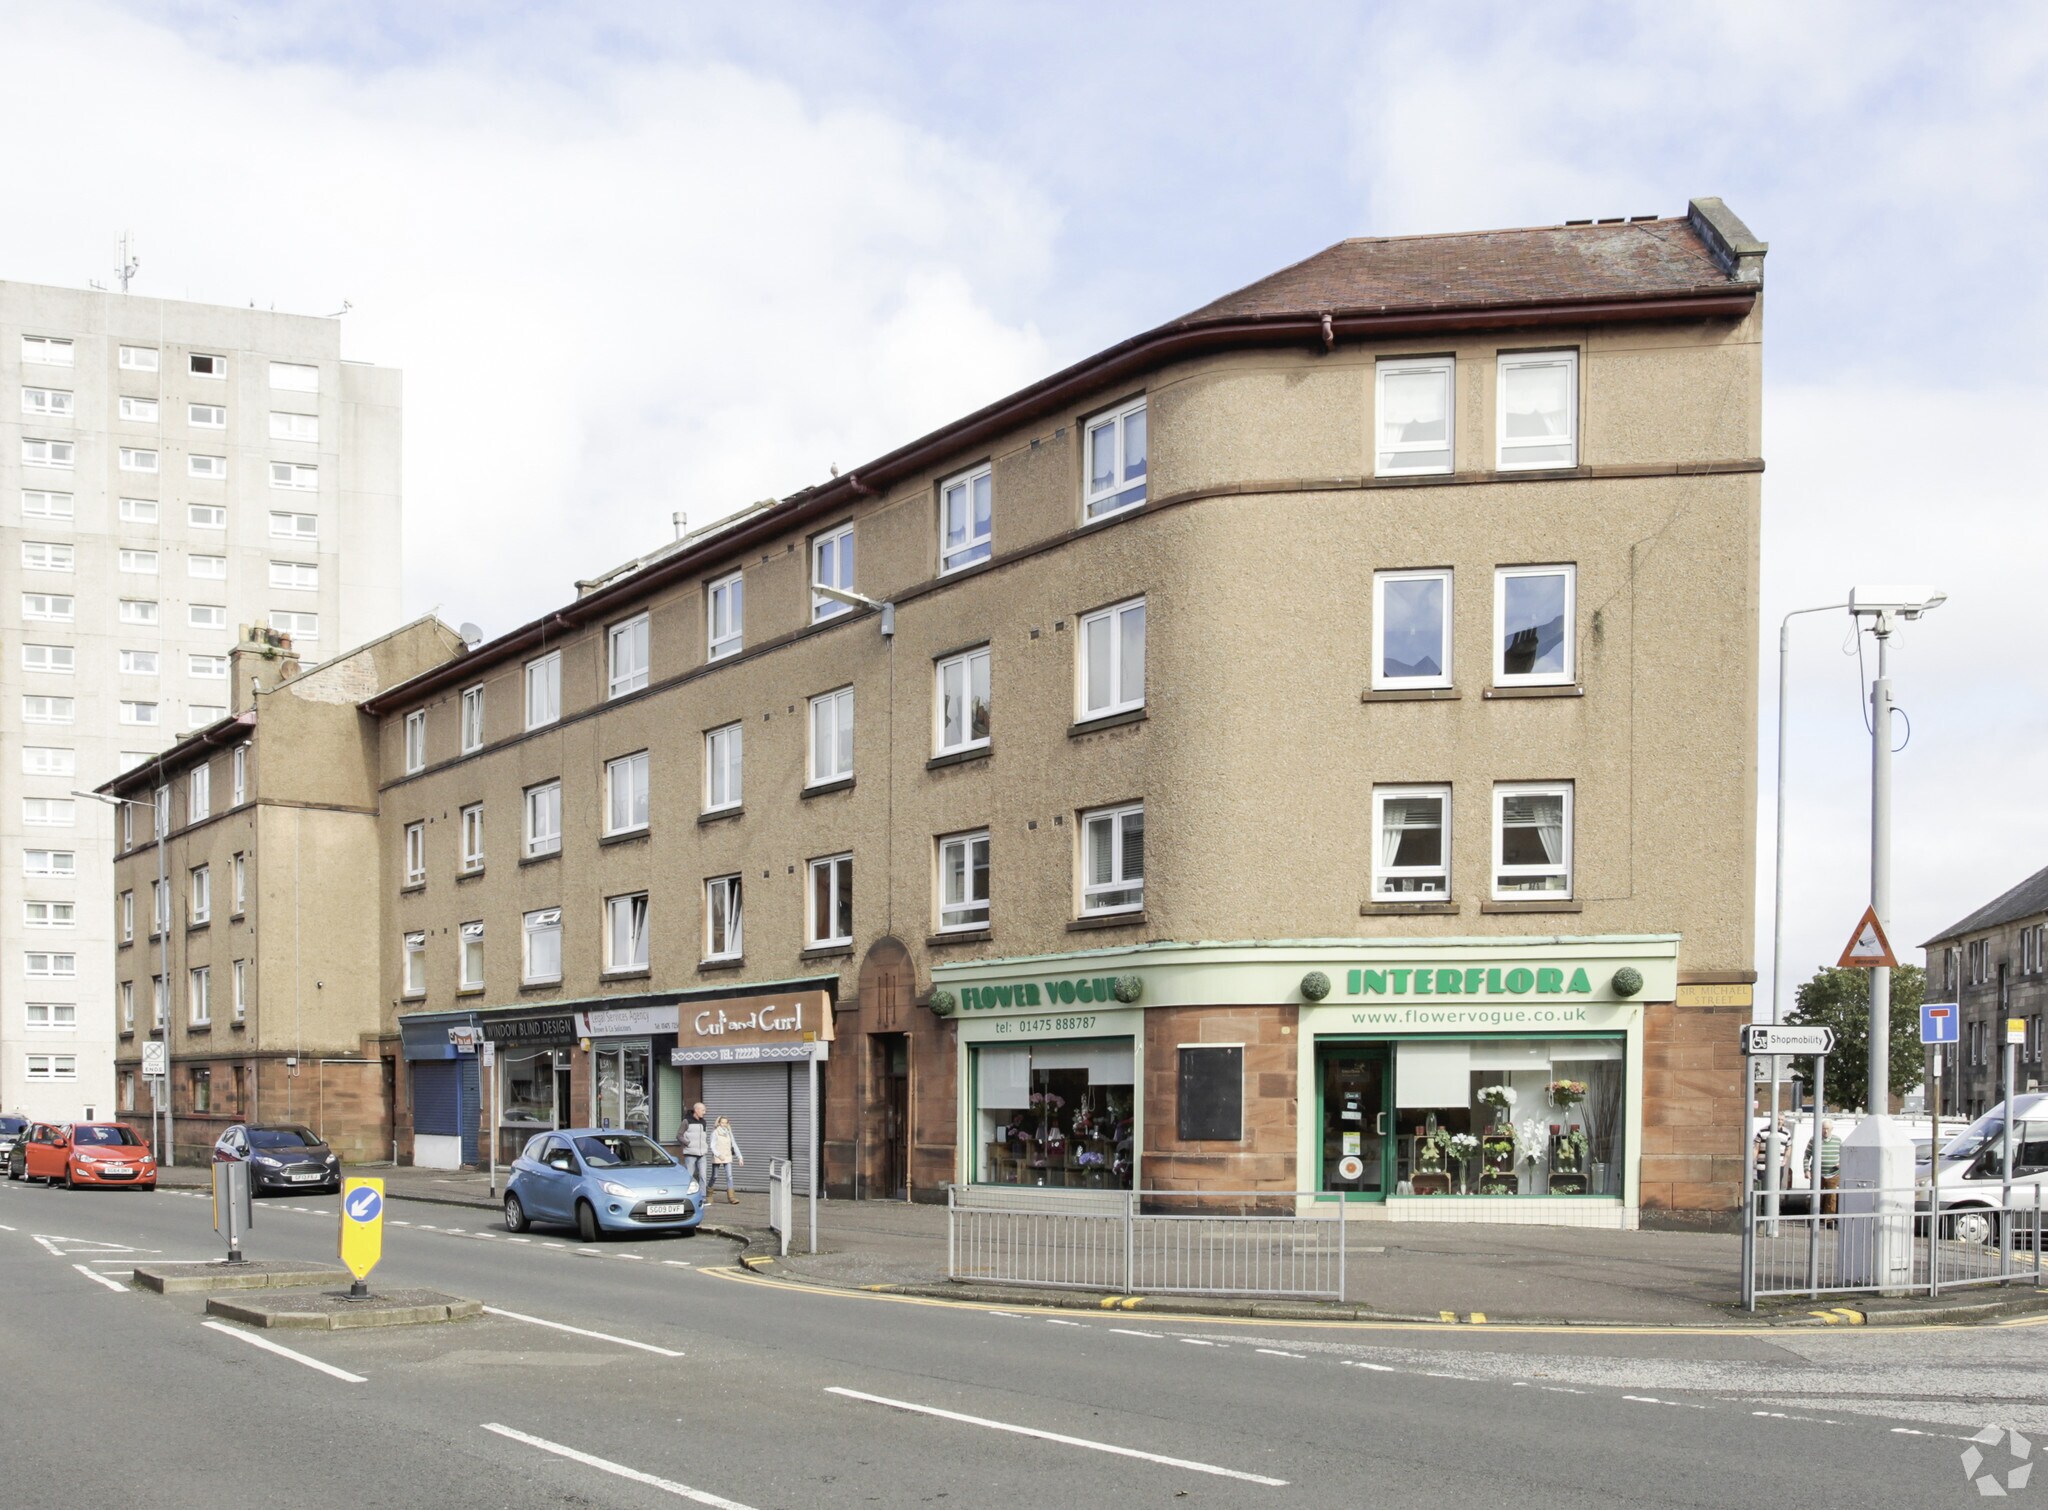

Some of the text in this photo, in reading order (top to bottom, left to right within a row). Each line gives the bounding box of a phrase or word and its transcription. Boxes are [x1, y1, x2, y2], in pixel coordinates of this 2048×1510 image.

[1347, 967, 1592, 995] INTERFLORA
[960, 983, 1041, 1010] FLOWER
[1680, 986, 1747, 996] SIR MICHAEL
[1695, 996, 1734, 1005] STREET
[605, 1011, 628, 1022] Services
[629, 1010, 649, 1023] Agency
[695, 1003, 801, 1036] Cut and Curl
[995, 1016, 1096, 1034] tel: 01475 888787
[1352, 1007, 1586, 1025] www.flowervogue.co.uk
[486, 1019, 571, 1037] WINDOW BLIND DESIGN
[1770, 1034, 1823, 1046] Shopmobility
